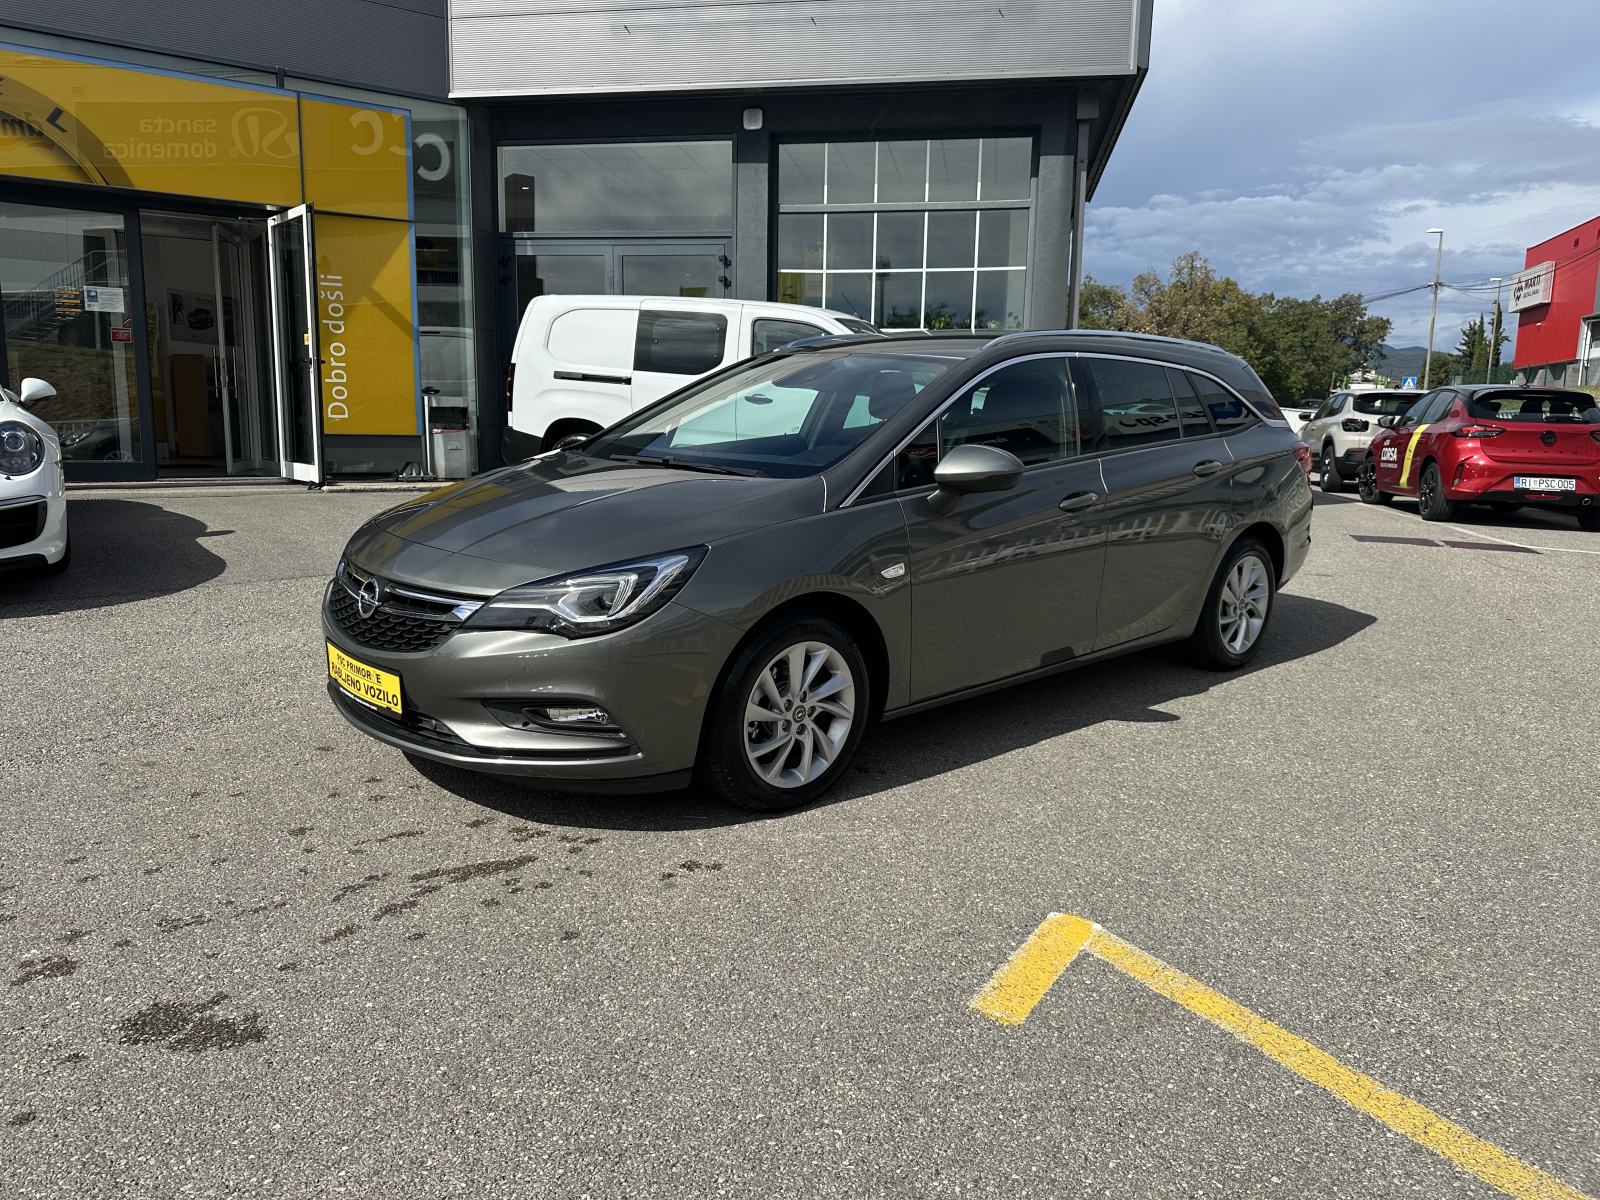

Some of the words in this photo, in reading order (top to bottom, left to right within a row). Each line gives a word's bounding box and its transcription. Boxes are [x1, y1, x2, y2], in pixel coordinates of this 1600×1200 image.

[320, 274, 346, 334] došli
[325, 341, 349, 419] Dobro
[1381, 447, 1397, 461] CORSA
[1521, 478, 1531, 487] RI
[363, 682, 399, 707] VOZILO
